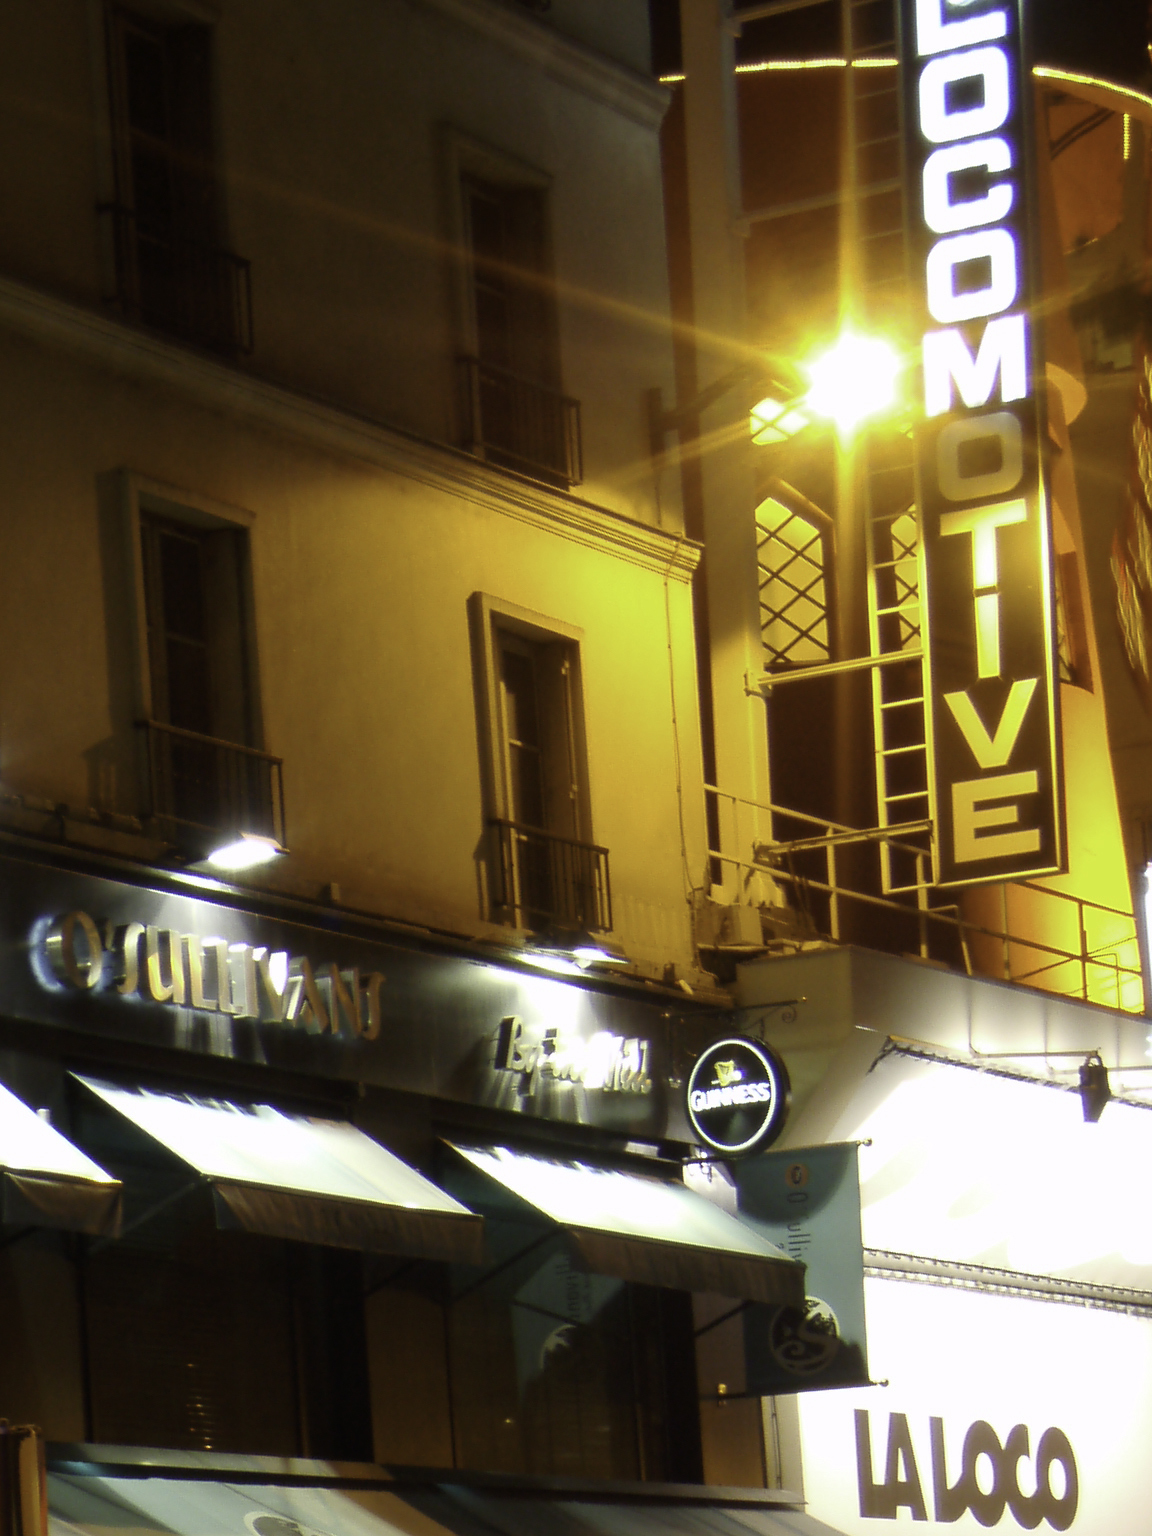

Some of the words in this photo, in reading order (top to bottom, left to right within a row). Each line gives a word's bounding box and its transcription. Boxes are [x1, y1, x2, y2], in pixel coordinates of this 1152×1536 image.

[691, 1083, 770, 1112] GUINNESS
[854, 1409, 928, 1521] LA
[929, 1416, 1078, 1531] LOCO
